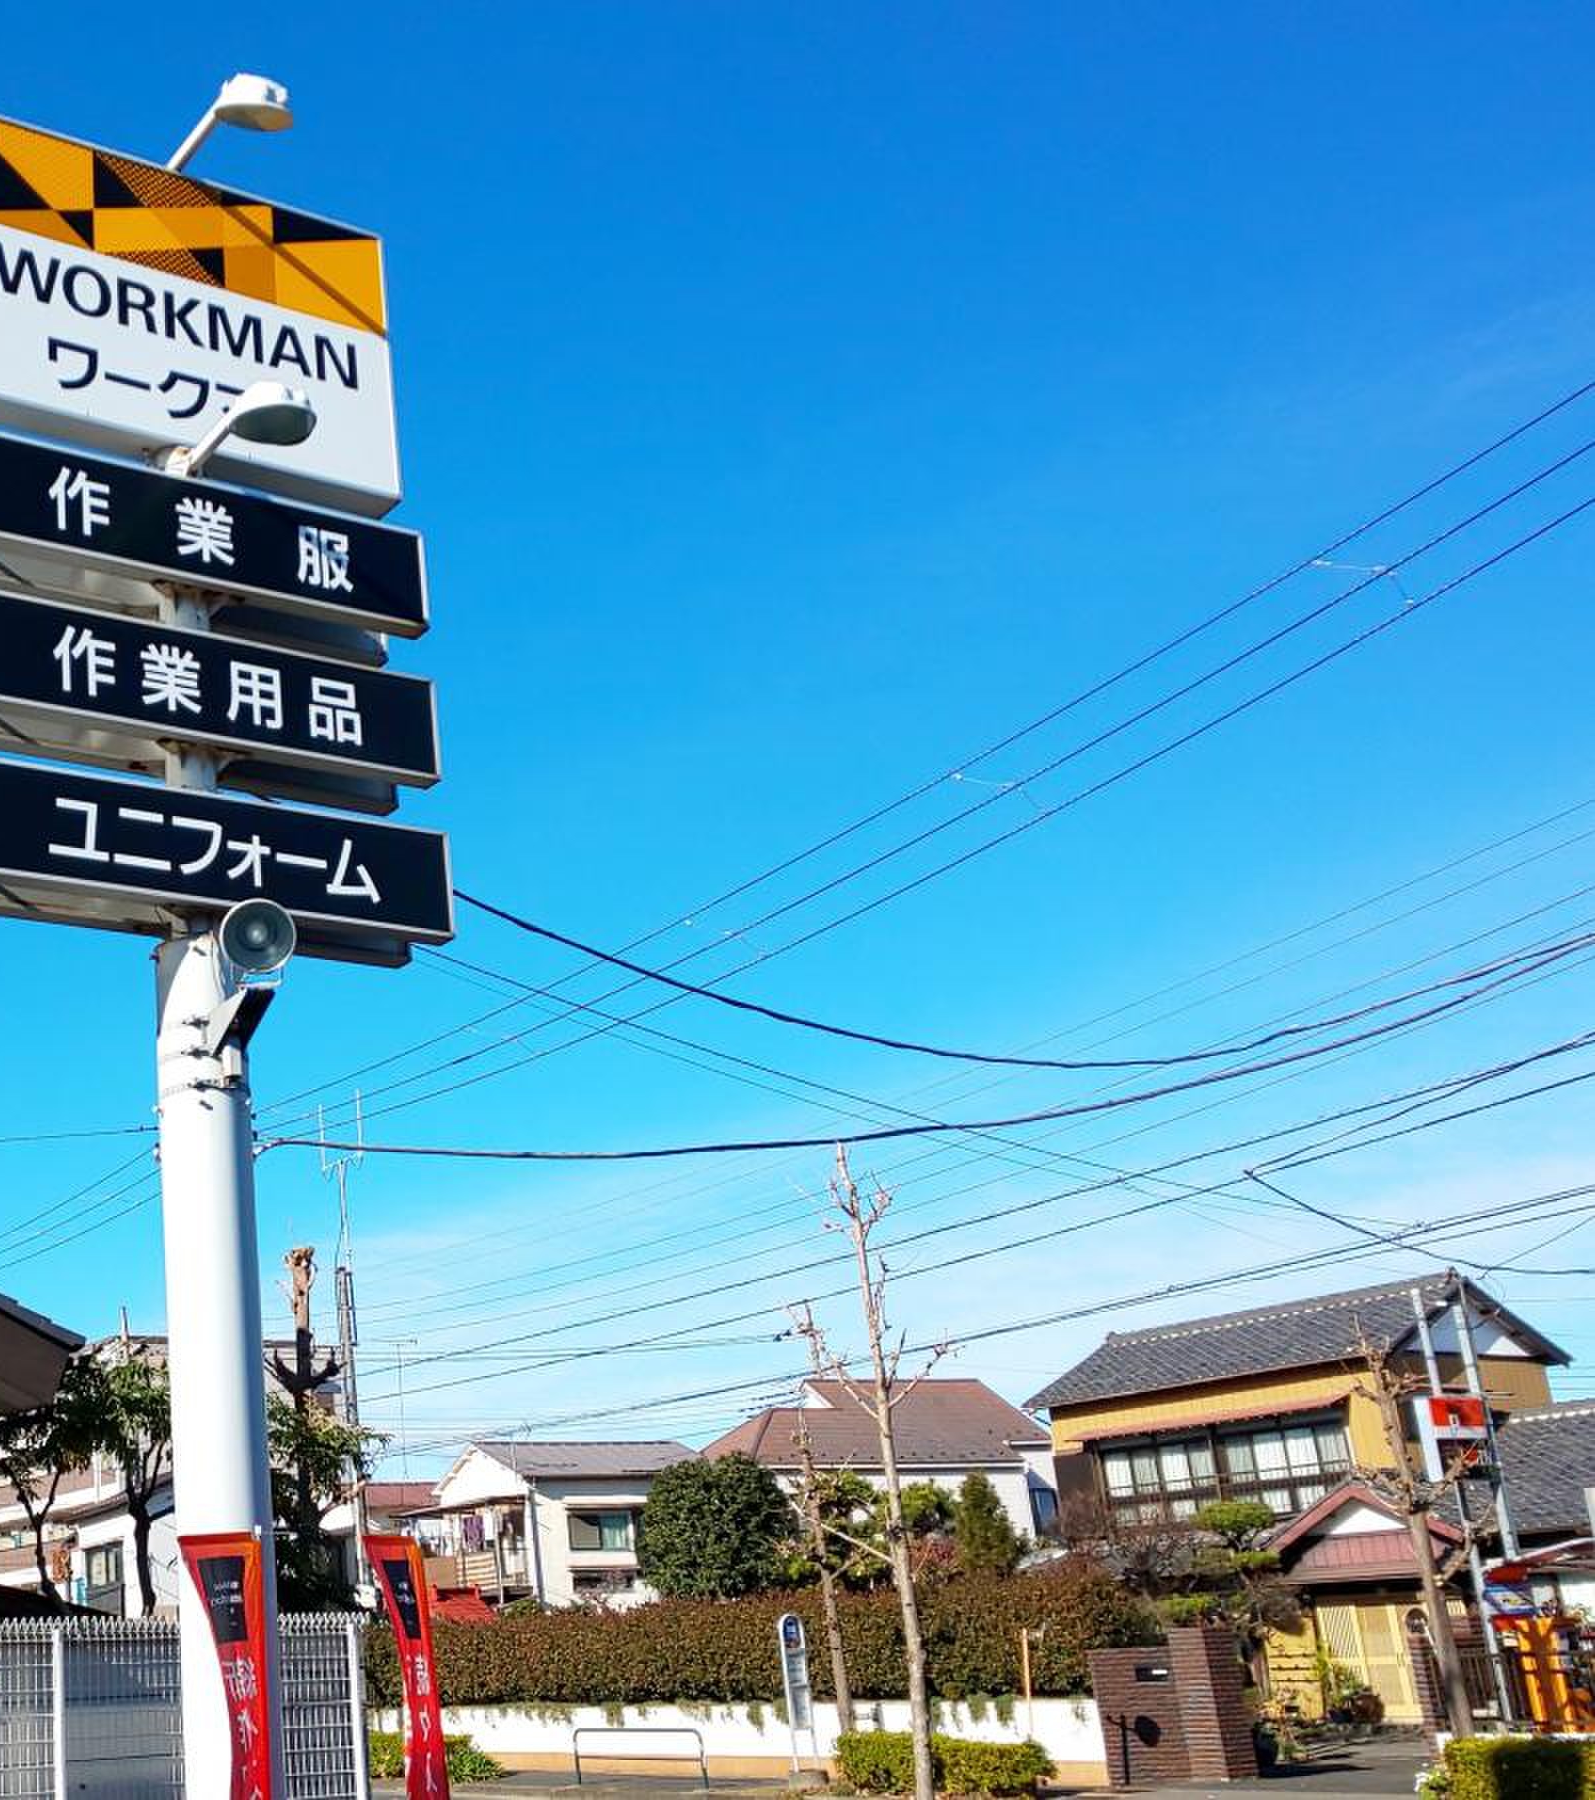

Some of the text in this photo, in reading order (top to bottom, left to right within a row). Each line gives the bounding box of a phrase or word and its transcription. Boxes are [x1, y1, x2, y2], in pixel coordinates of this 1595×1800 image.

[48, 337, 247, 419] ワーク
[48, 466, 355, 593] 作業服
[52, 625, 364, 747] 作業用品
[48, 797, 381, 904] ユニフォーム
